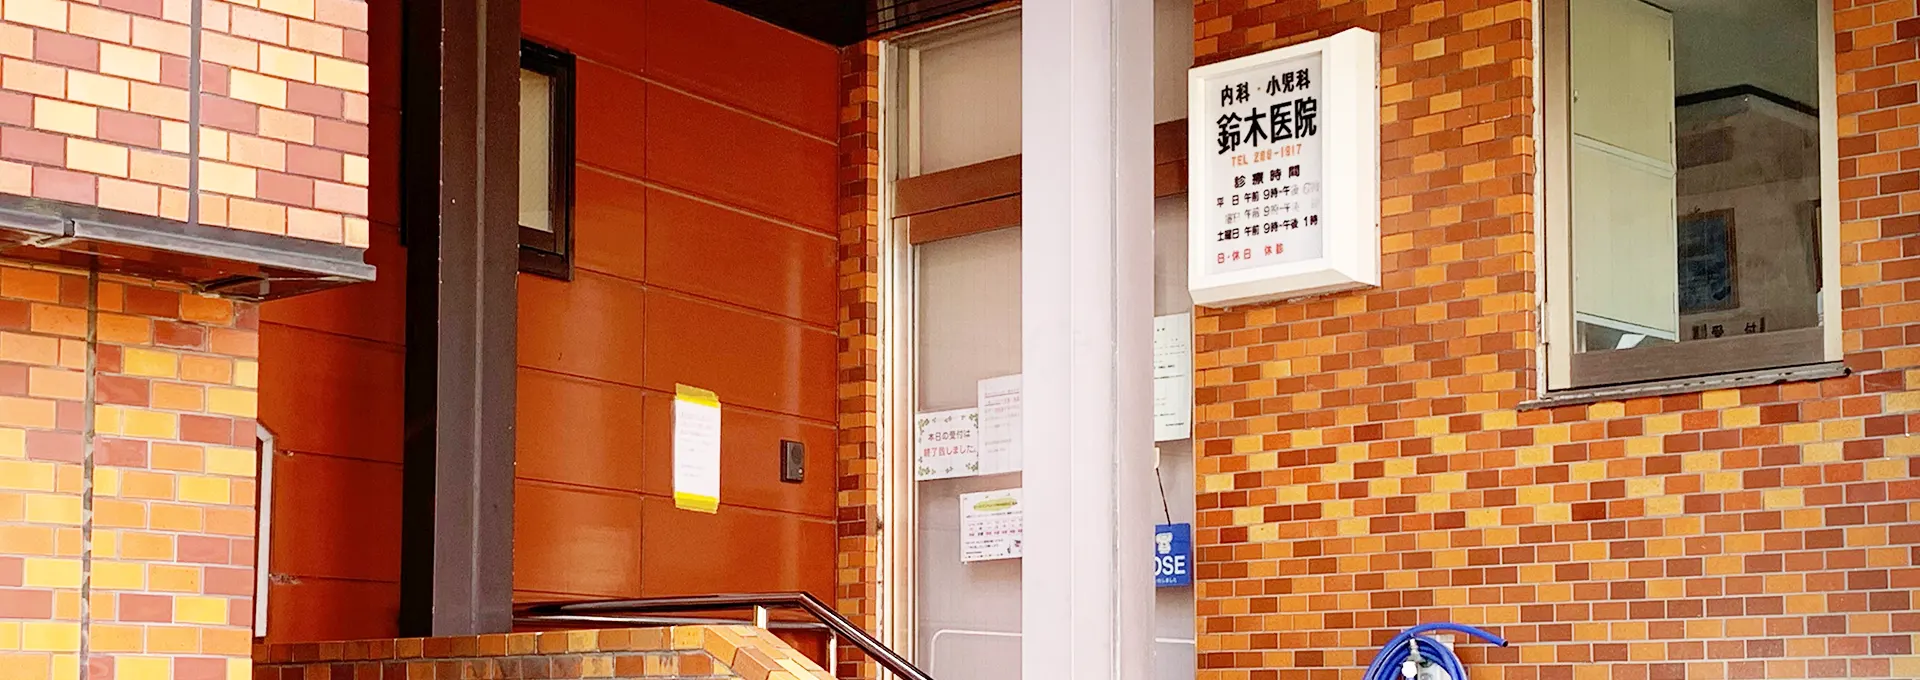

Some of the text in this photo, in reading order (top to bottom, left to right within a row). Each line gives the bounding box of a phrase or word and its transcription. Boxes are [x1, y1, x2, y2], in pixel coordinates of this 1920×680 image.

[1216, 96, 1317, 155] 鈴木医院
[1231, 154, 1248, 167] TEL
[1234, 164, 1301, 188] 診療時間
[1244, 191, 1260, 203] 午前
[1217, 228, 1239, 242] 土曜日
[1244, 225, 1260, 237] 午前
[1304, 215, 1318, 227] 1時
[1264, 243, 1284, 256] 休診
[928, 430, 971, 441] 本日の受付は
[1155, 555, 1186, 577] OSE
